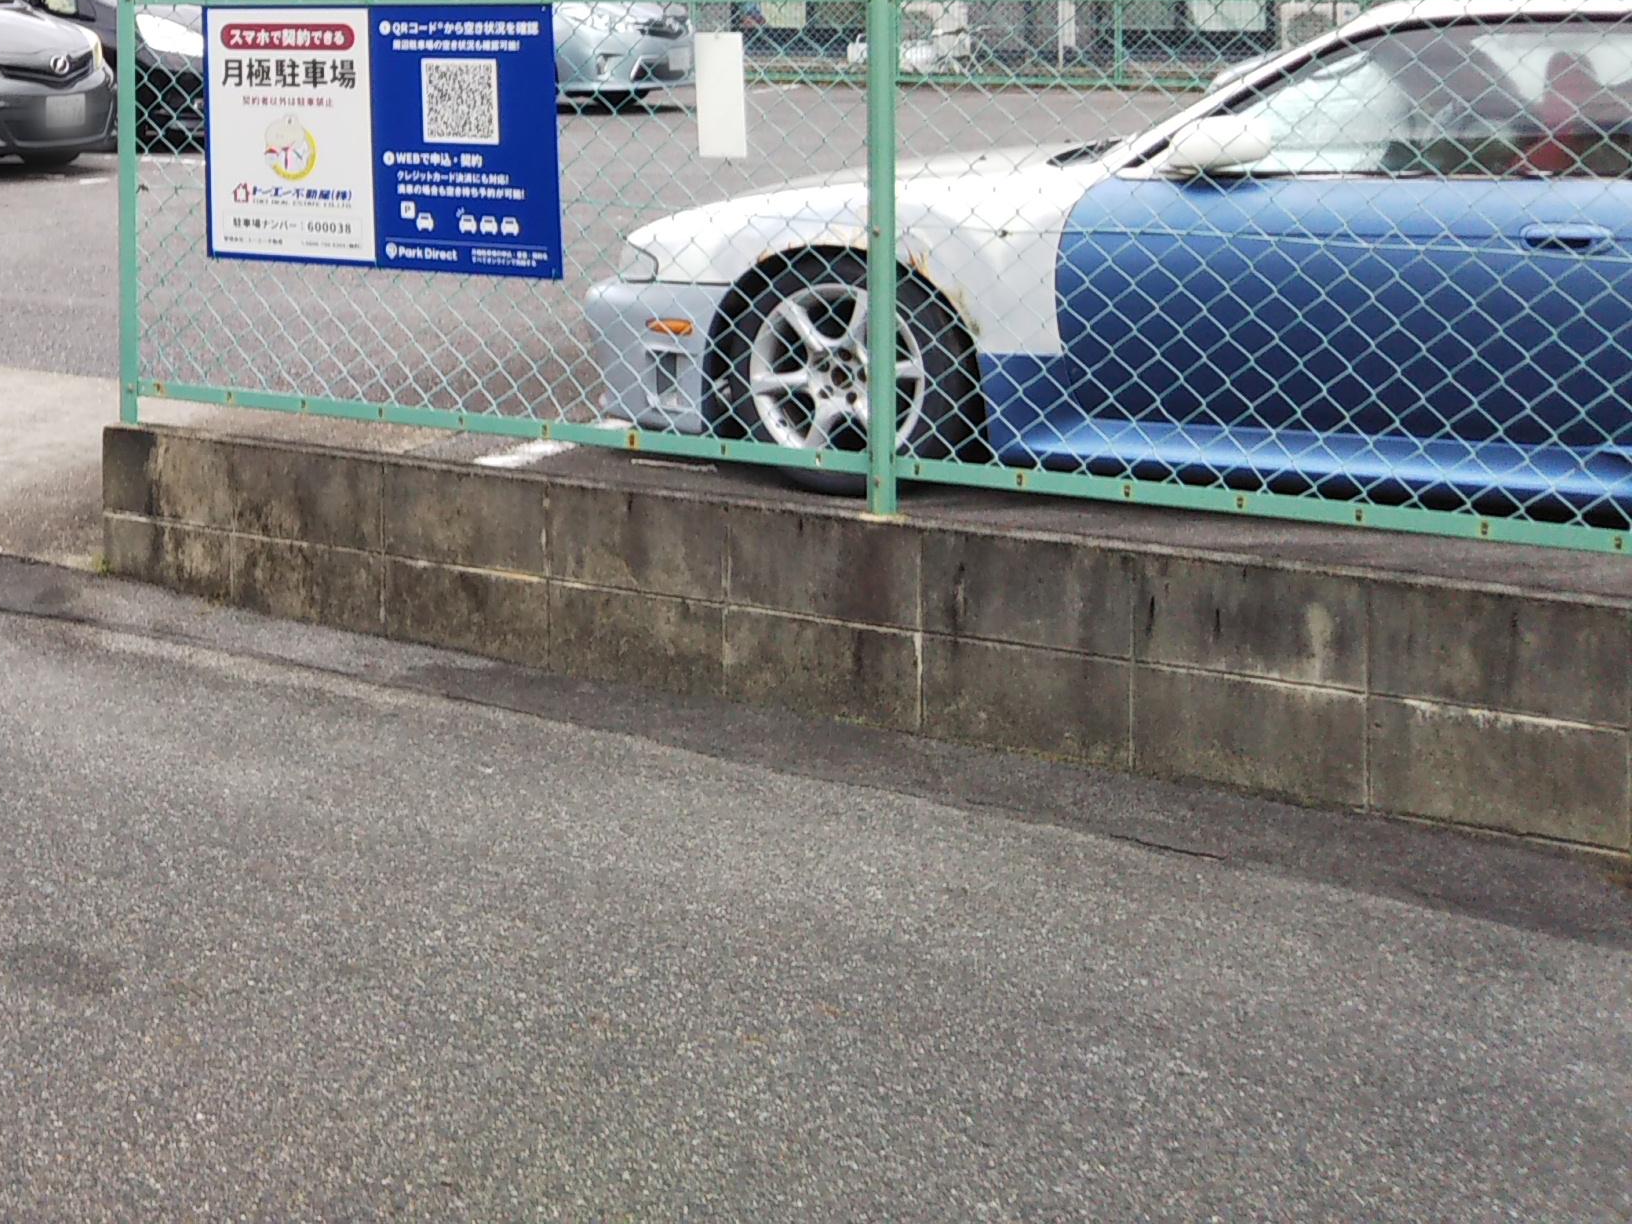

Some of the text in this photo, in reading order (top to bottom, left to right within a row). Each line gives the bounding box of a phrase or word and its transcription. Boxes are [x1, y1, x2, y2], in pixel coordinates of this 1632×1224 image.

[230, 29, 345, 47] スマホで契約できる
[222, 58, 356, 89] 月極駐車場
[398, 246, 422, 258] Park
[424, 248, 458, 261] Direct
